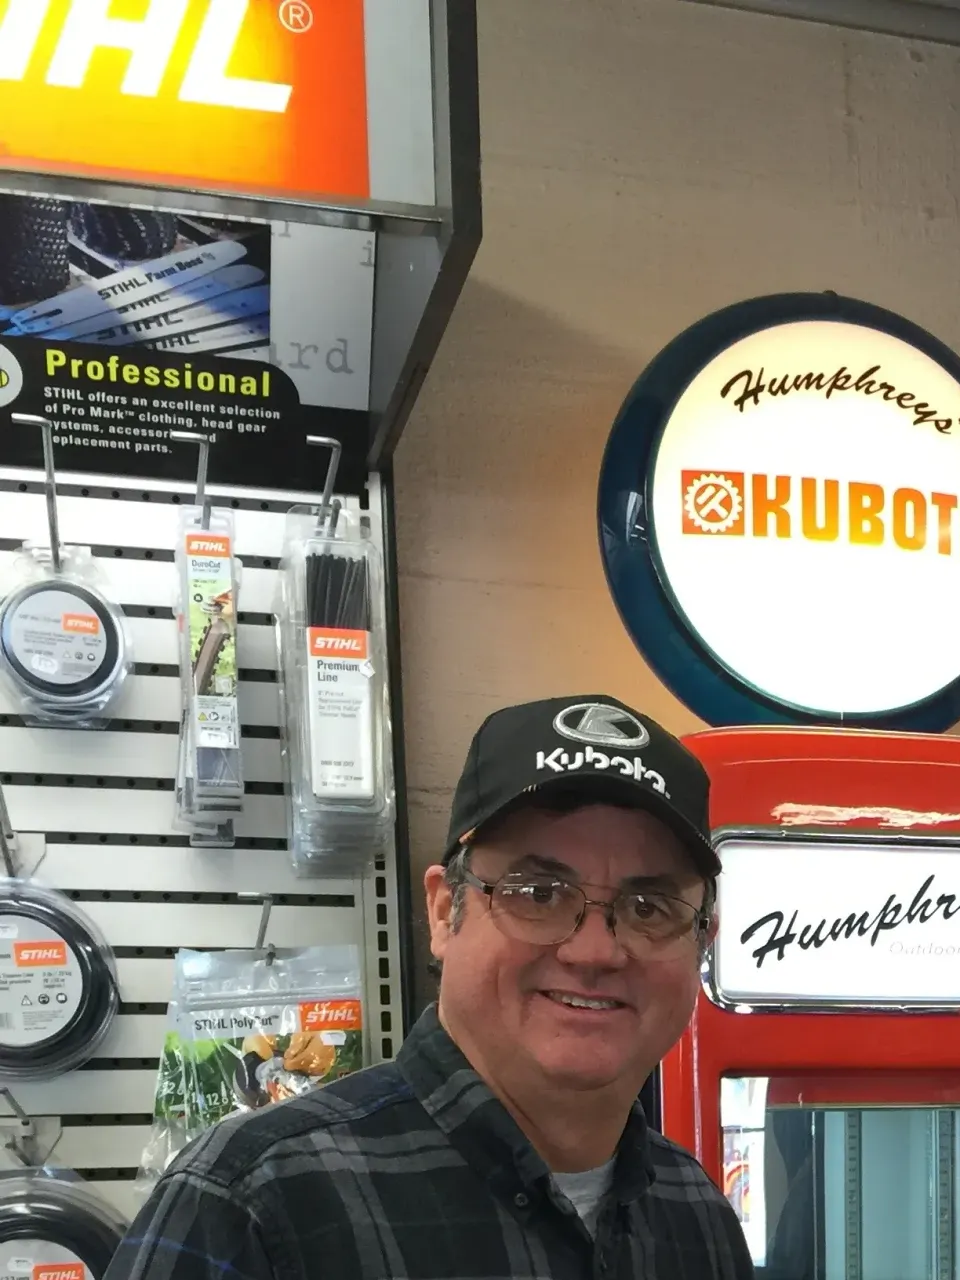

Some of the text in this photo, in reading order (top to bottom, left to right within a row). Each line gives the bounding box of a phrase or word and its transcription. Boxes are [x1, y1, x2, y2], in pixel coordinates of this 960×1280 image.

[97, 277, 147, 301] STIHL
[46, 349, 270, 397] Professional
[44, 387, 280, 420] STIHL offers an excellent selection
[45, 403, 58, 413] of
[62, 404, 85, 416] Pro
[201, 417, 233, 430] head
[237, 421, 266, 435] gear
[52, 434, 173, 454] eplacement parts.
[190, 540, 226, 552] STIHL
[314, 637, 361, 651] STIHL
[317, 660, 360, 673] Premium
[317, 671, 338, 682] Line
[536, 746, 671, 799] Kubota
[20, 949, 62, 960] STIHL
[305, 1008, 356, 1023] STIHL
